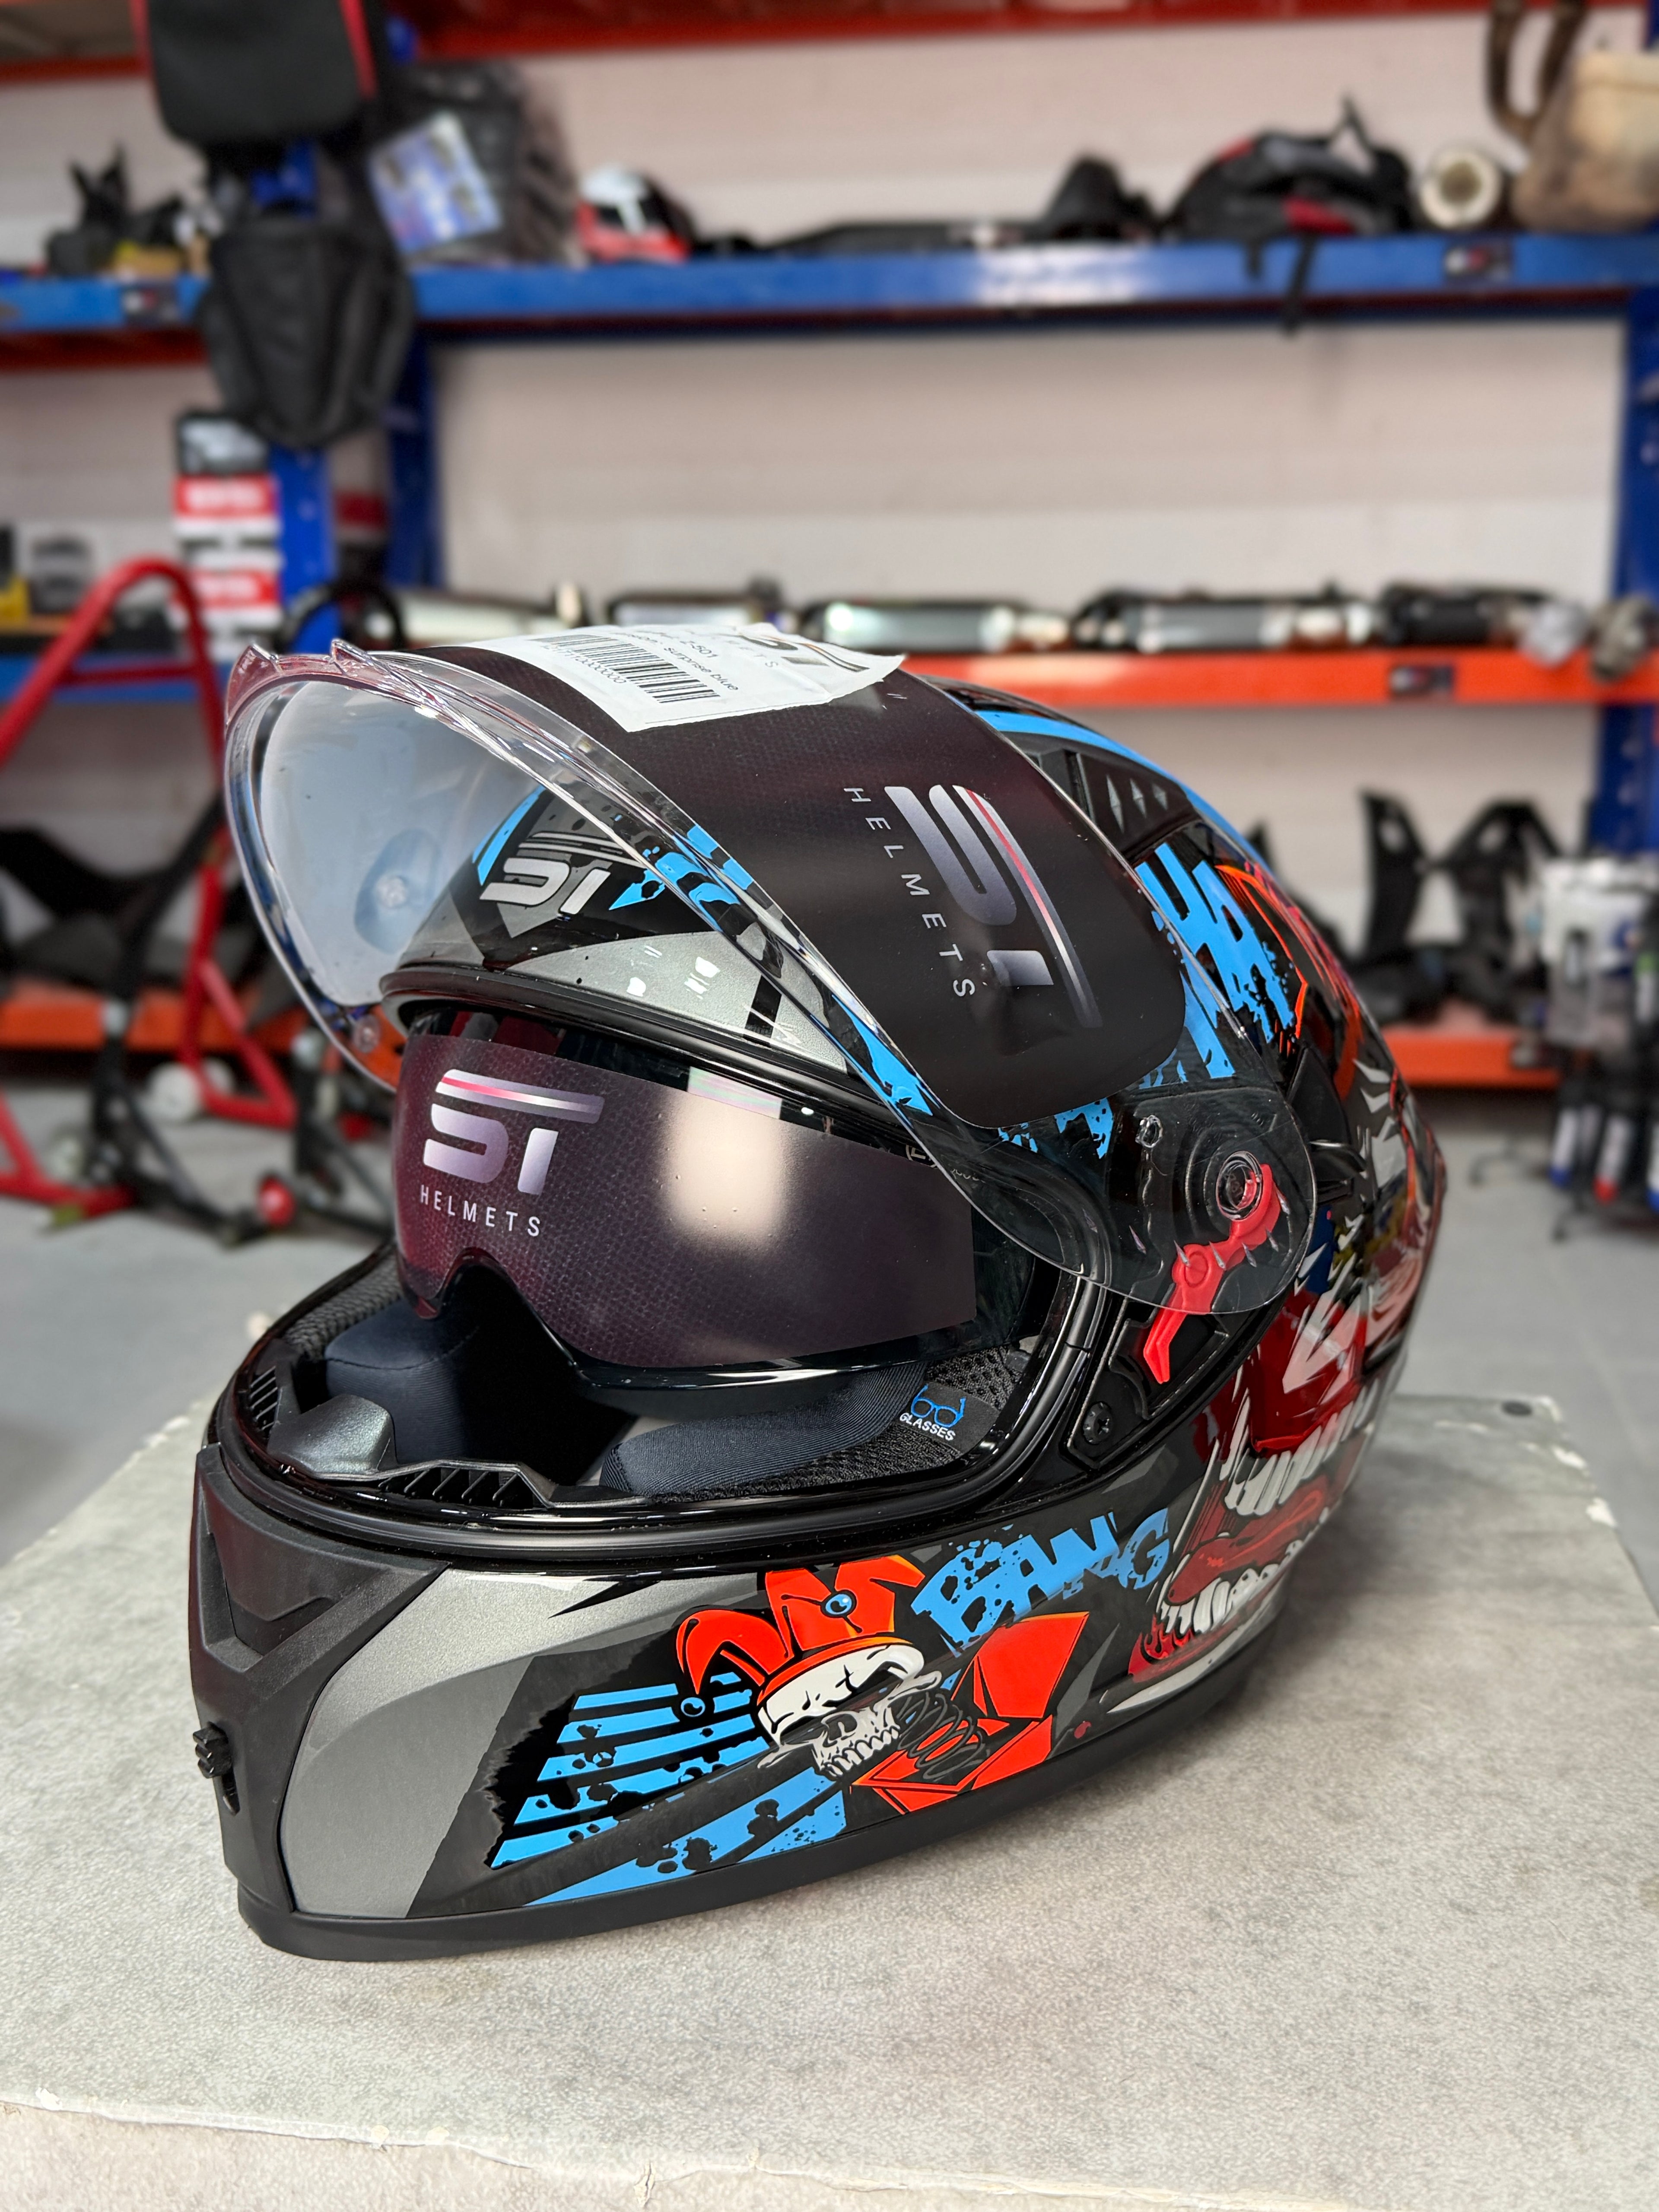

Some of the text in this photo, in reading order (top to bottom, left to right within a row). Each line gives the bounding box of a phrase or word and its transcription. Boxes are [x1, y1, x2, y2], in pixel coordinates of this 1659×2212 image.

[710, 674, 739, 691] blue
[844, 788, 975, 997] HELMETS
[884, 785, 1103, 1027] ST
[423, 1069, 604, 1195] ST
[420, 1184, 540, 1236] HELMETS
[899, 1412, 956, 1441] GLASSES
[911, 1508, 1169, 1657] BANG
